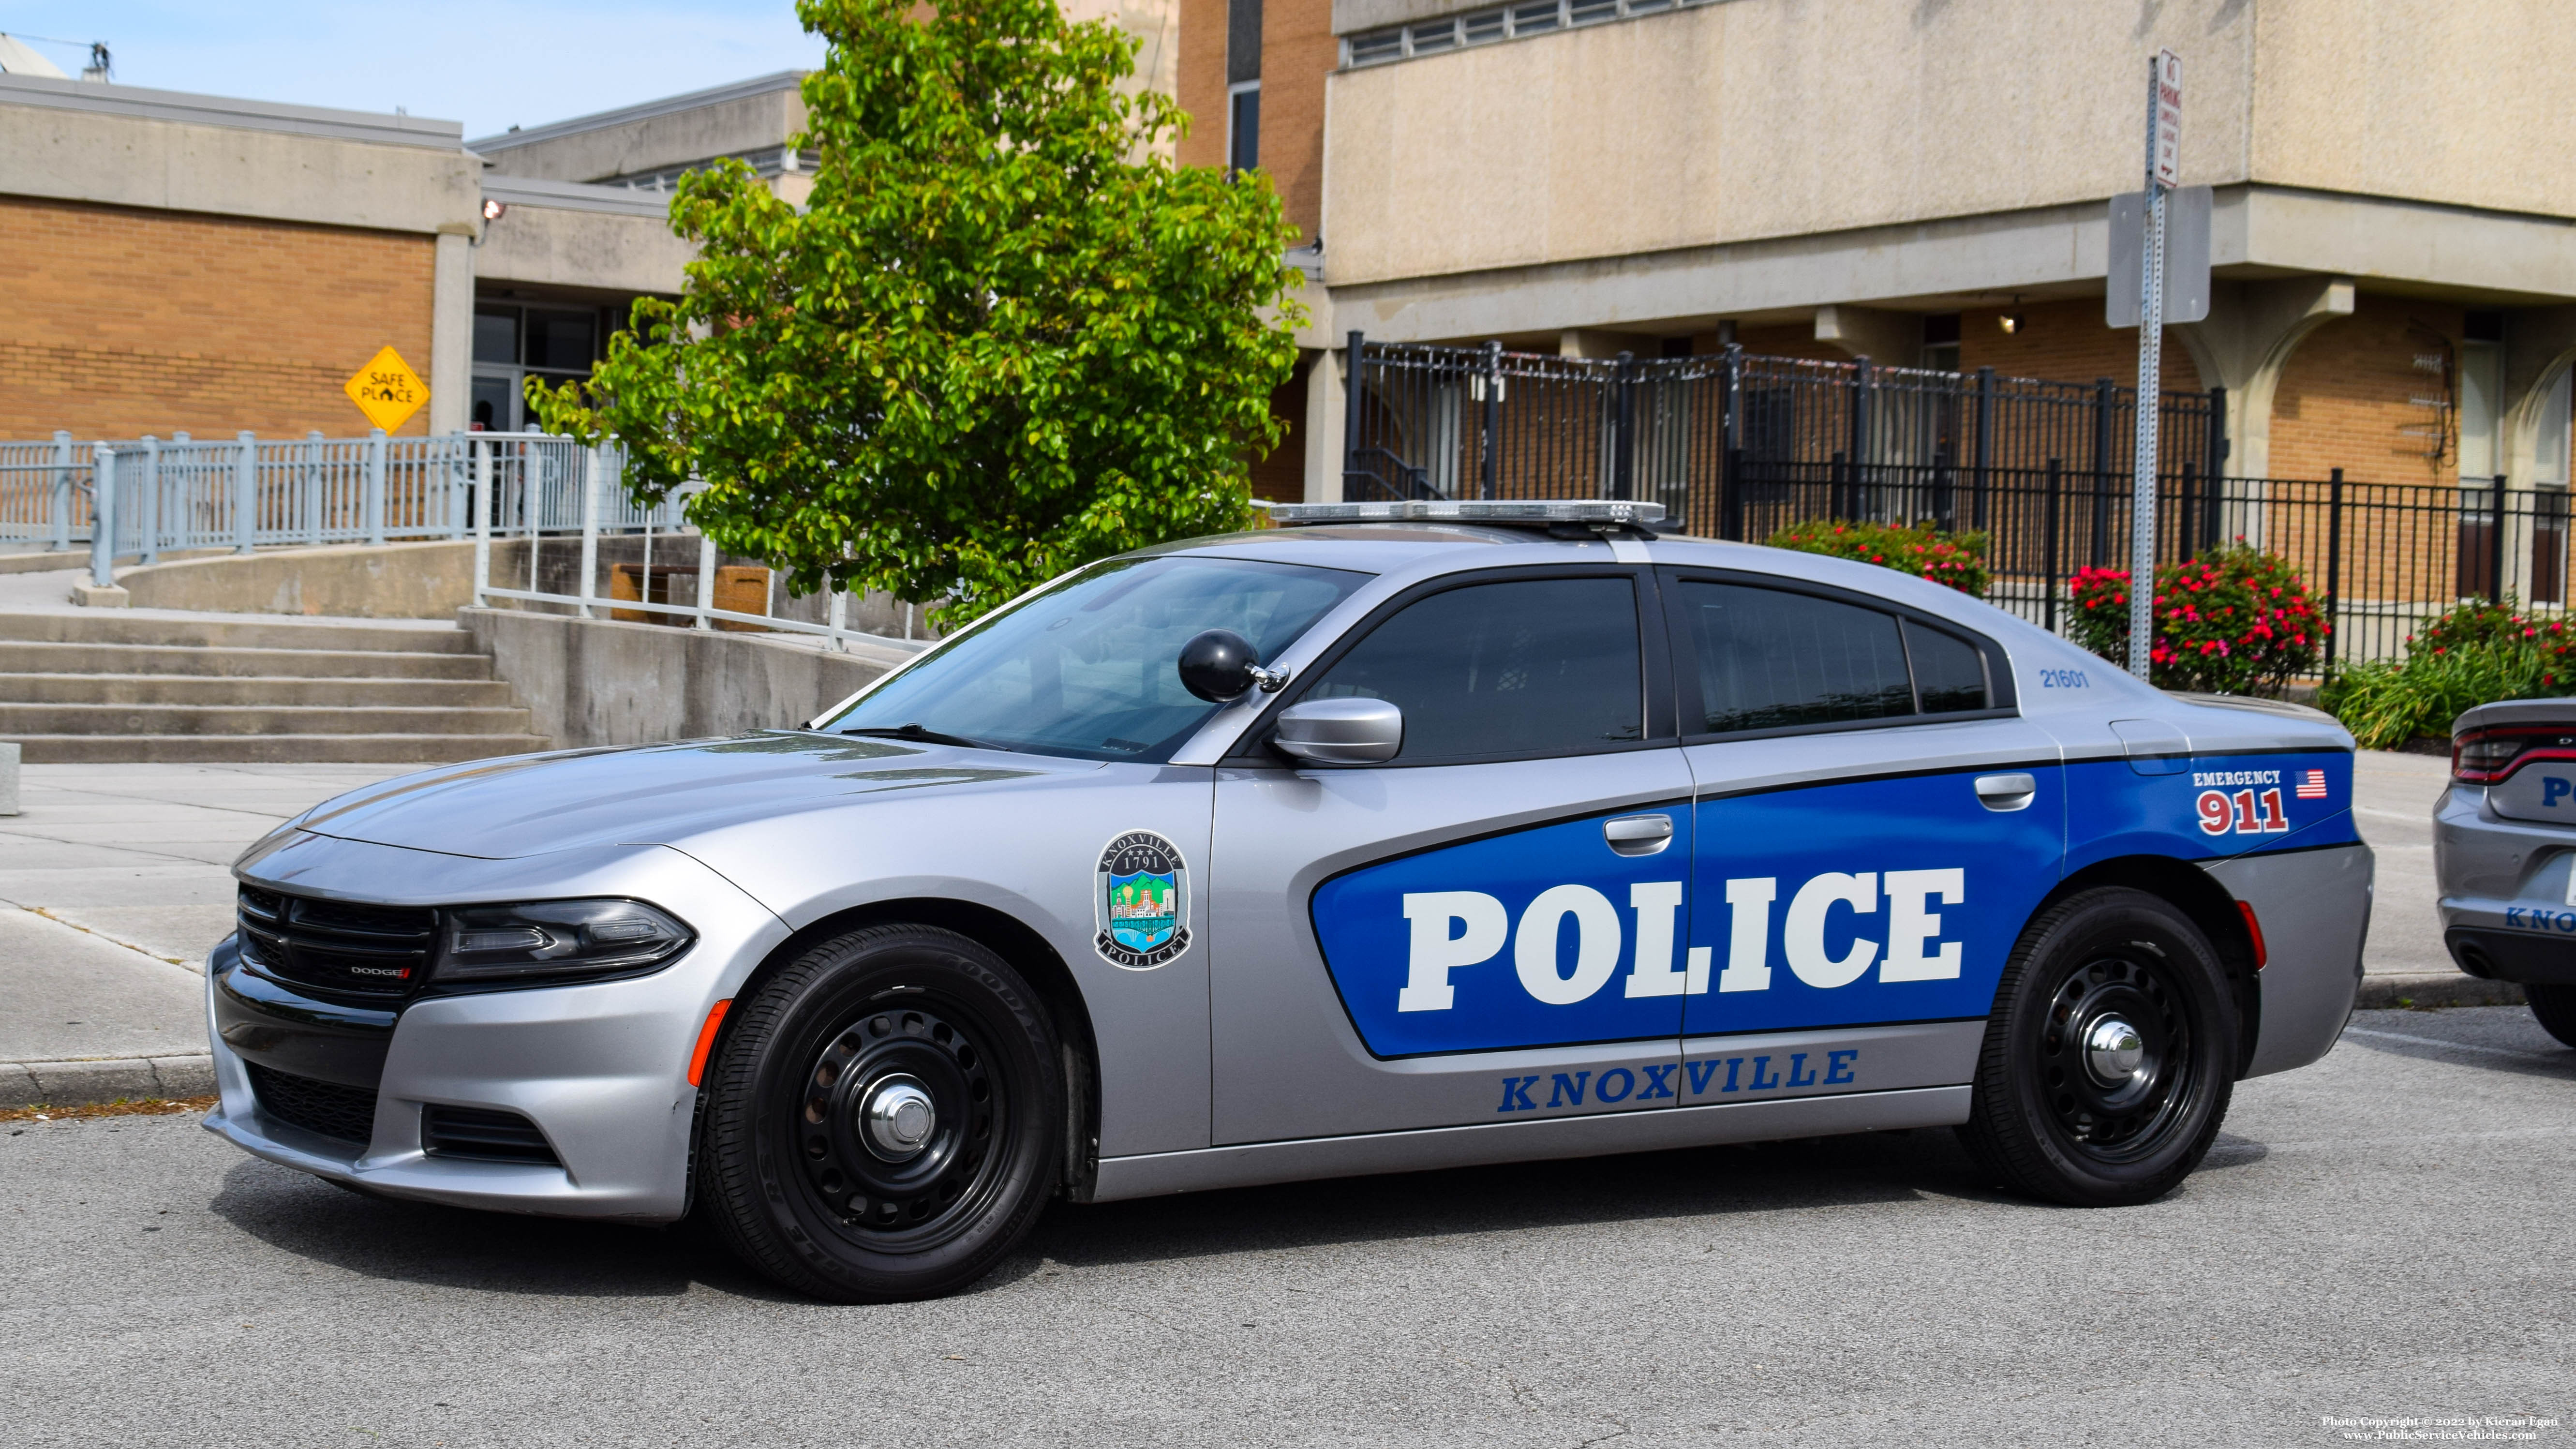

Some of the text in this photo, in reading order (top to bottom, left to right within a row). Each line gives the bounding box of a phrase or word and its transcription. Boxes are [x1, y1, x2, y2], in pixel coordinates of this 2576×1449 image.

[370, 372, 404, 387] SAFE
[2040, 669, 2089, 688] 21601
[2192, 770, 2280, 787] EMERGENCY
[2196, 788, 2289, 836] 911
[1102, 834, 1180, 867] KNOXVILLE
[1124, 856, 1159, 869] 1791
[1397, 867, 1965, 1013] POLICE
[1106, 942, 1181, 966] POLICE
[351, 967, 404, 976] DODGE
[1497, 1048, 1859, 1113] KNOXVILLE
